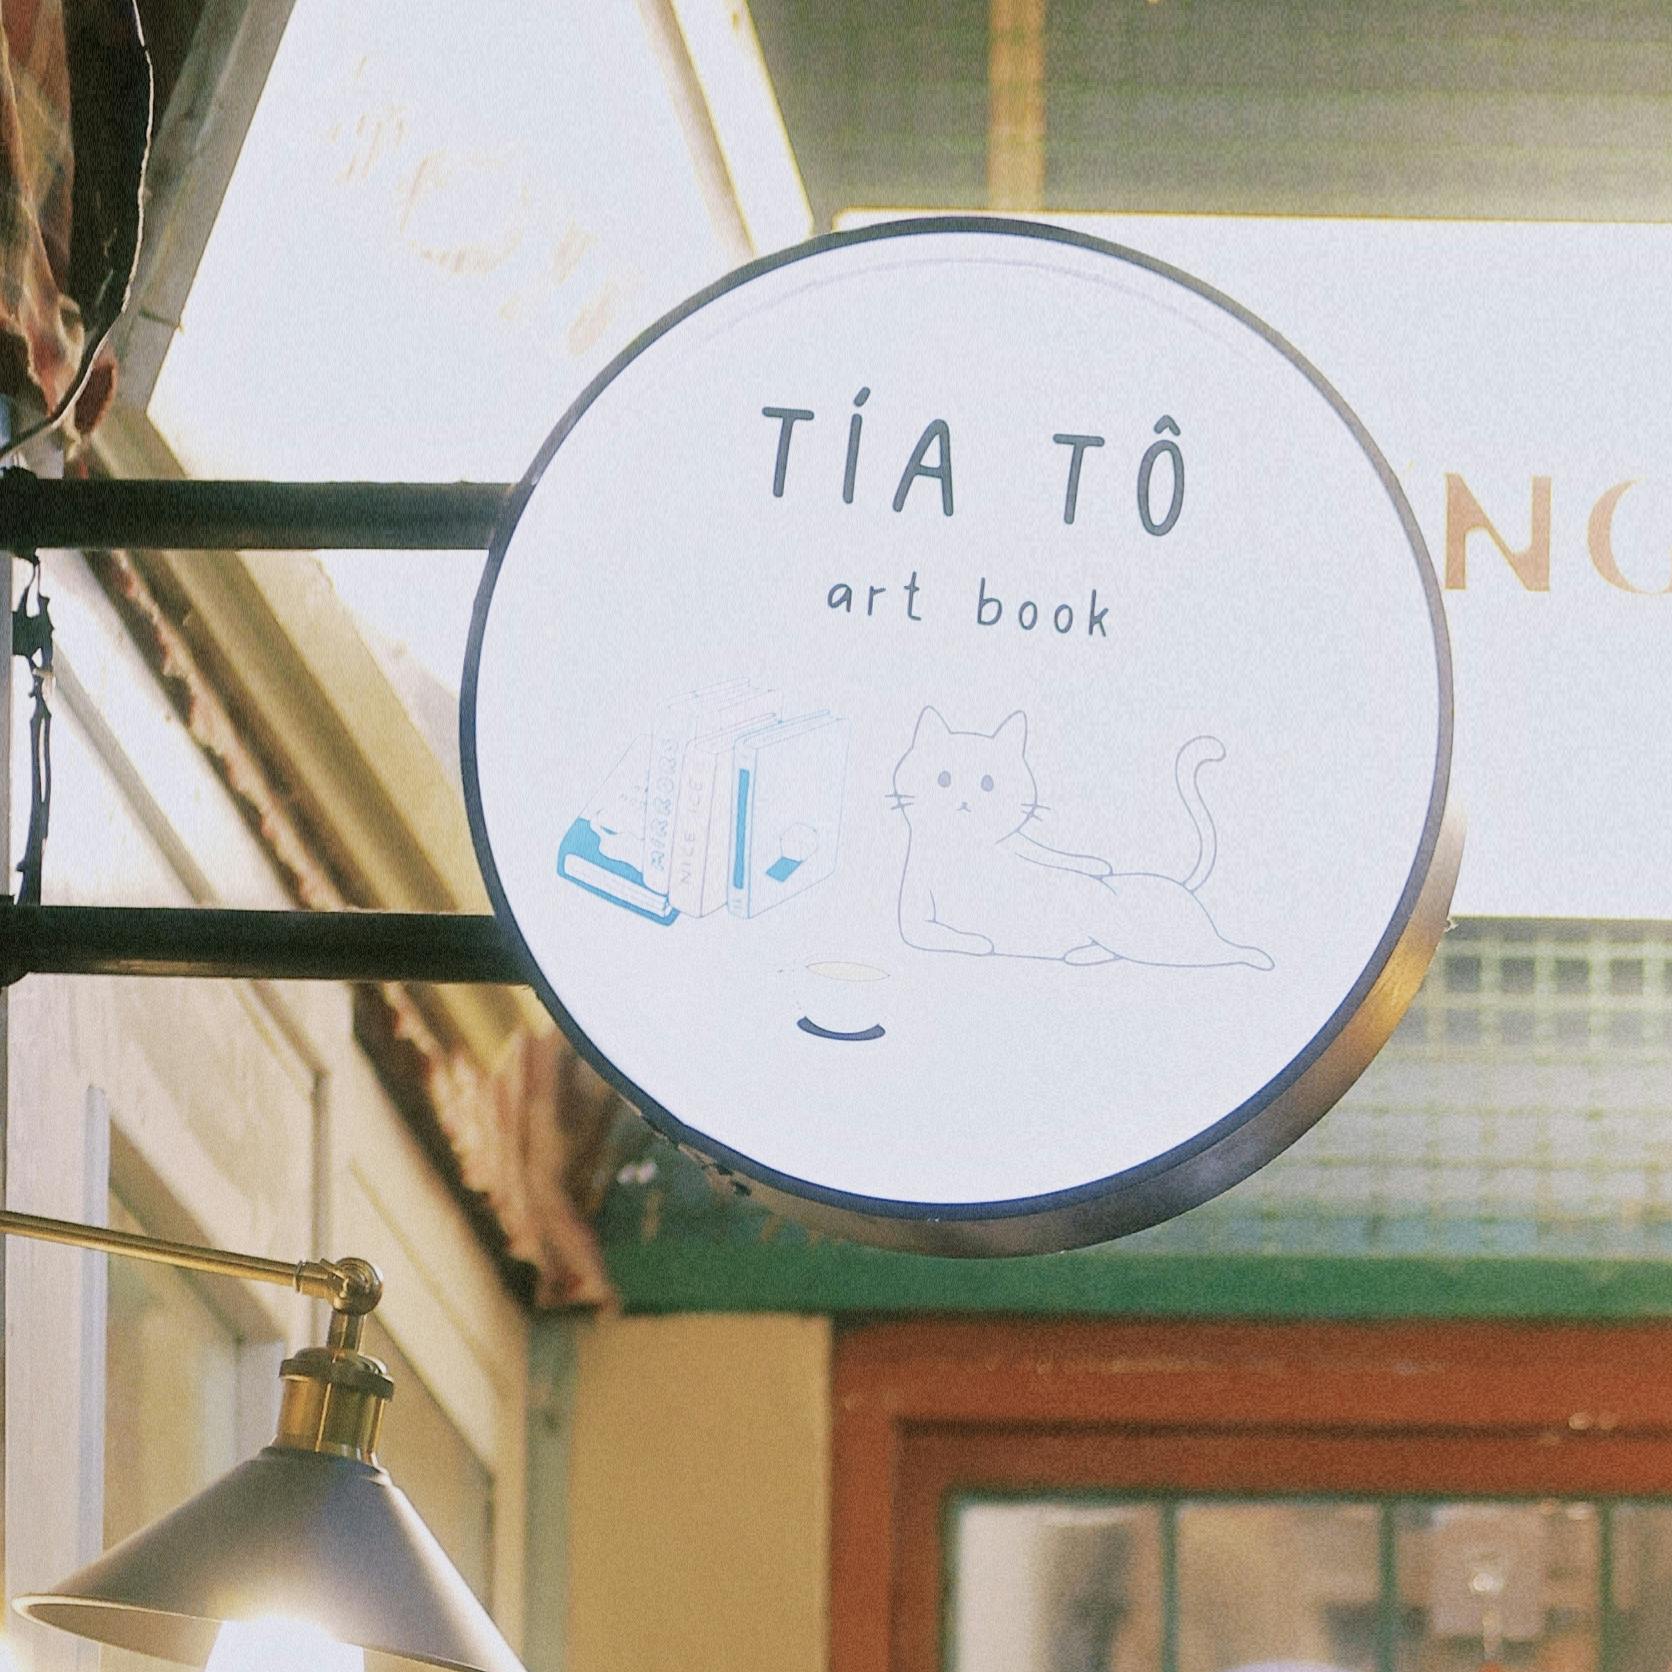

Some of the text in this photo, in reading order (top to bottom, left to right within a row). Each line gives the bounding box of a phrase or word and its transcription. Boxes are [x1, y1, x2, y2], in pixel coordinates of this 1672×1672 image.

[762, 387, 1186, 536] TÍA TÔ
[827, 570, 1108, 637] art book
